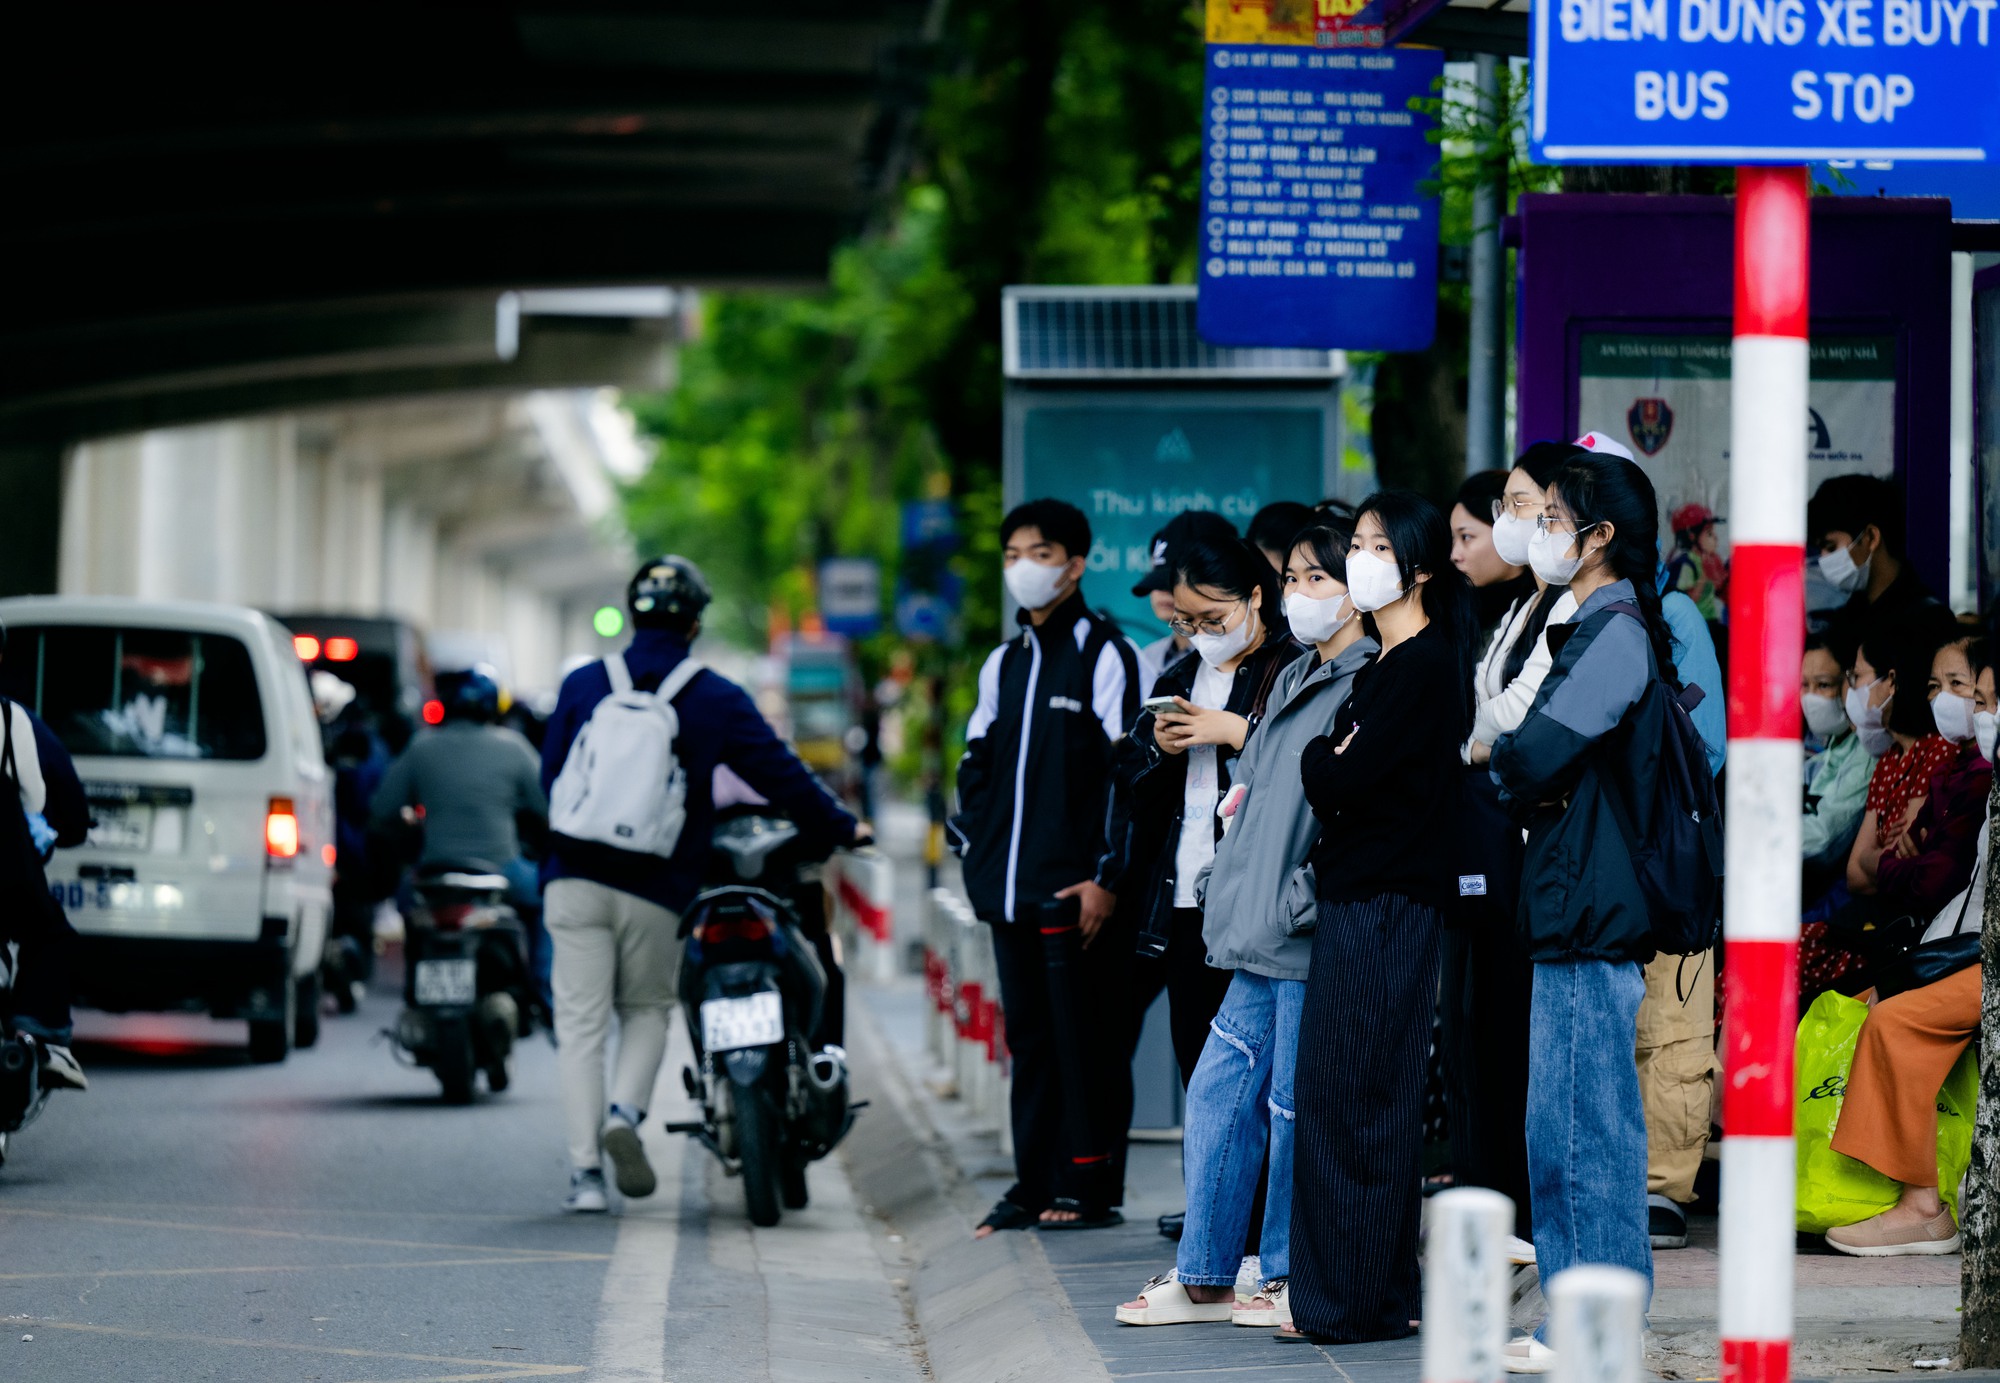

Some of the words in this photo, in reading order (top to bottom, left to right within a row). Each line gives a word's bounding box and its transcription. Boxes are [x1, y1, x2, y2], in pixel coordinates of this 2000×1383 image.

[1817, 0, 1875, 47] XE
[1634, 70, 1730, 120] BUS
[1791, 70, 1914, 123] STOP
[1091, 490, 1145, 515] Thu
